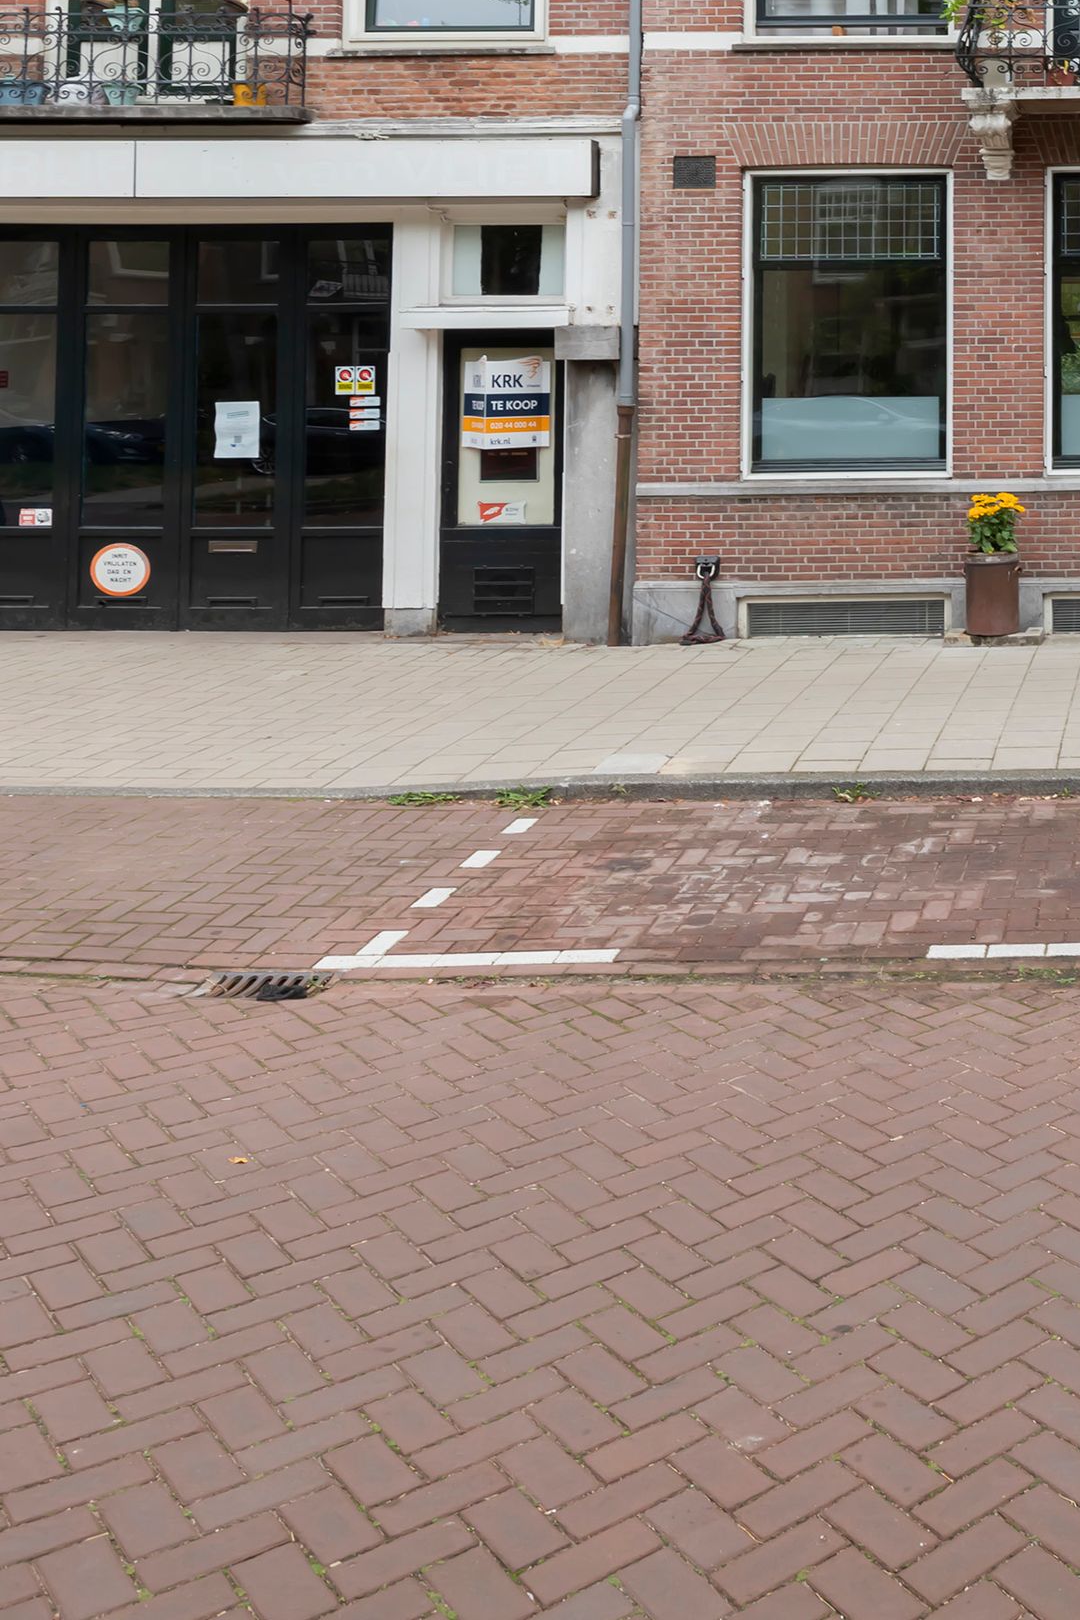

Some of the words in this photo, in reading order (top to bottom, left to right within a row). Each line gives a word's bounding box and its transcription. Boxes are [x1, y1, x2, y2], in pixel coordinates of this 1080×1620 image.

[491, 374, 524, 389] KRK
[490, 400, 504, 411] TE
[505, 399, 538, 411] KOOP
[490, 421, 503, 430] 020
[504, 421, 513, 430] 44
[490, 437, 511, 445] krk.nl
